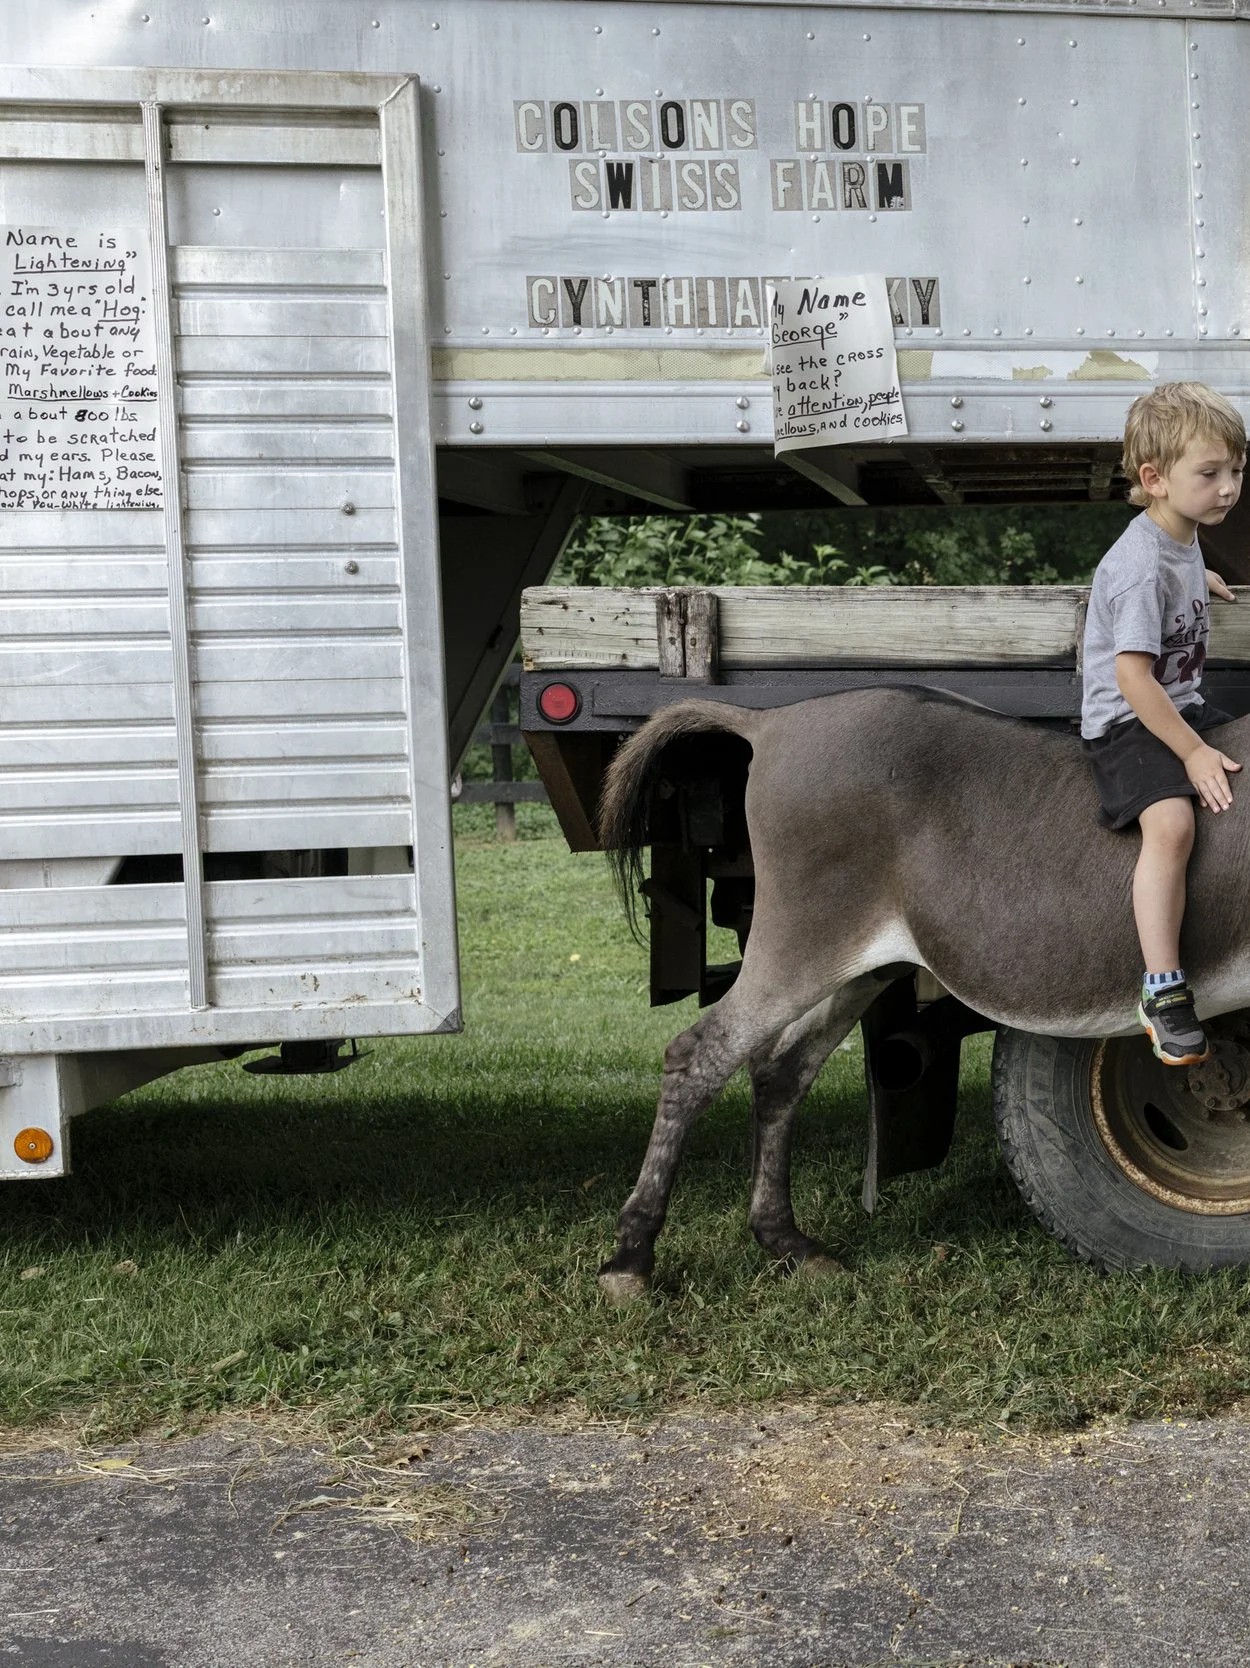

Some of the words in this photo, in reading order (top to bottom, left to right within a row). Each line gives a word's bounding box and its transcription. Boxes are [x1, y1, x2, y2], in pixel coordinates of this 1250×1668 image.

[517, 100, 756, 152] COLSONS
[798, 101, 922, 152] HOPE
[573, 160, 740, 210] SWISS
[775, 161, 905, 210] FARM
[6, 229, 78, 248] Name
[98, 233, 117, 249] is
[10, 280, 40, 296] I'm
[105, 275, 136, 295] old
[5, 301, 43, 317] call
[797, 287, 867, 316] Name
[43, 321, 104, 339] about
[42, 343, 116, 365] Vegetable
[122, 350, 144, 358] or
[798, 355, 828, 371] the
[5, 363, 31, 381] My
[40, 363, 117, 377] Favorite
[786, 369, 843, 393] back?
[869, 387, 899, 410] people
[14, 406, 68, 420] about
[114, 406, 138, 422] lbs
[3, 428, 28, 444] to
[37, 429, 58, 444] be
[19, 452, 44, 468] my
[101, 448, 156, 462] Please
[42, 490, 57, 499] or
